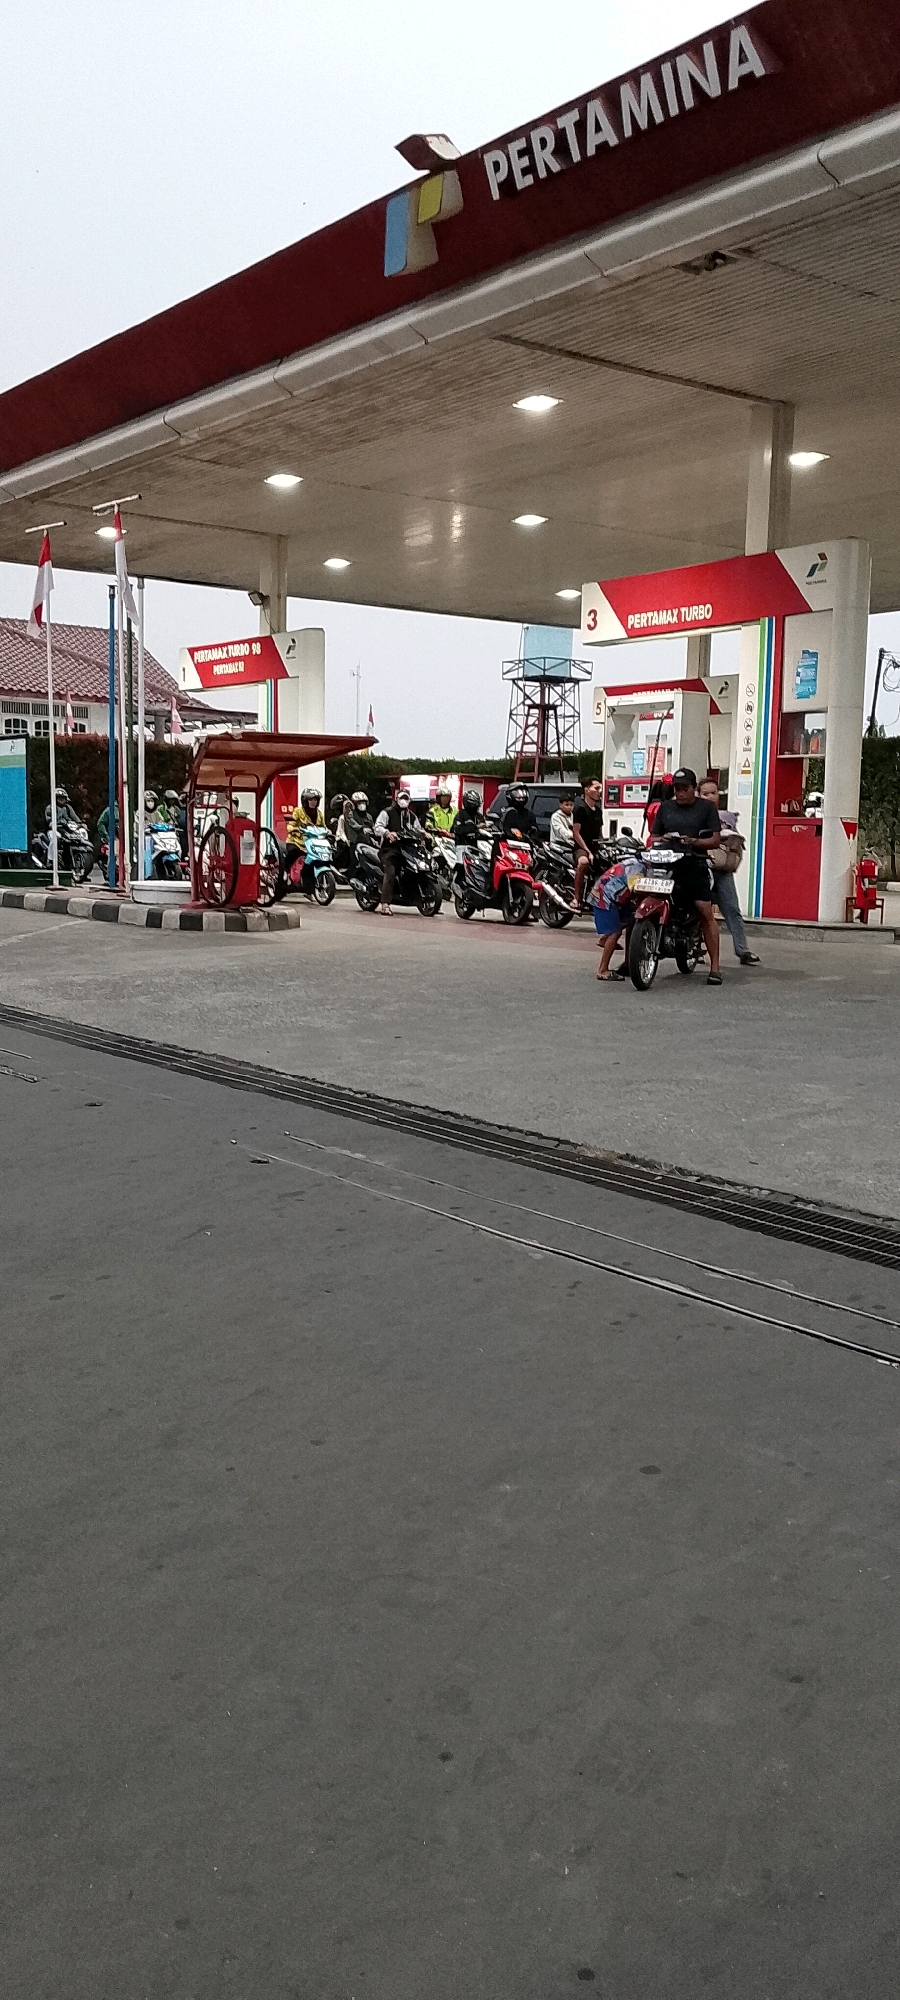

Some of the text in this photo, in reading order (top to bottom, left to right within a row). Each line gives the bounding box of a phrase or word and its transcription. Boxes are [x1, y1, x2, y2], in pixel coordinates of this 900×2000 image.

[484, 25, 766, 200] PERTAMINA
[587, 609, 598, 631] 3
[627, 603, 713, 630] PERTAMAX TURBO
[193, 642, 262, 665] PERTAMAX TURBO 98
[595, 702, 602, 716] 5
